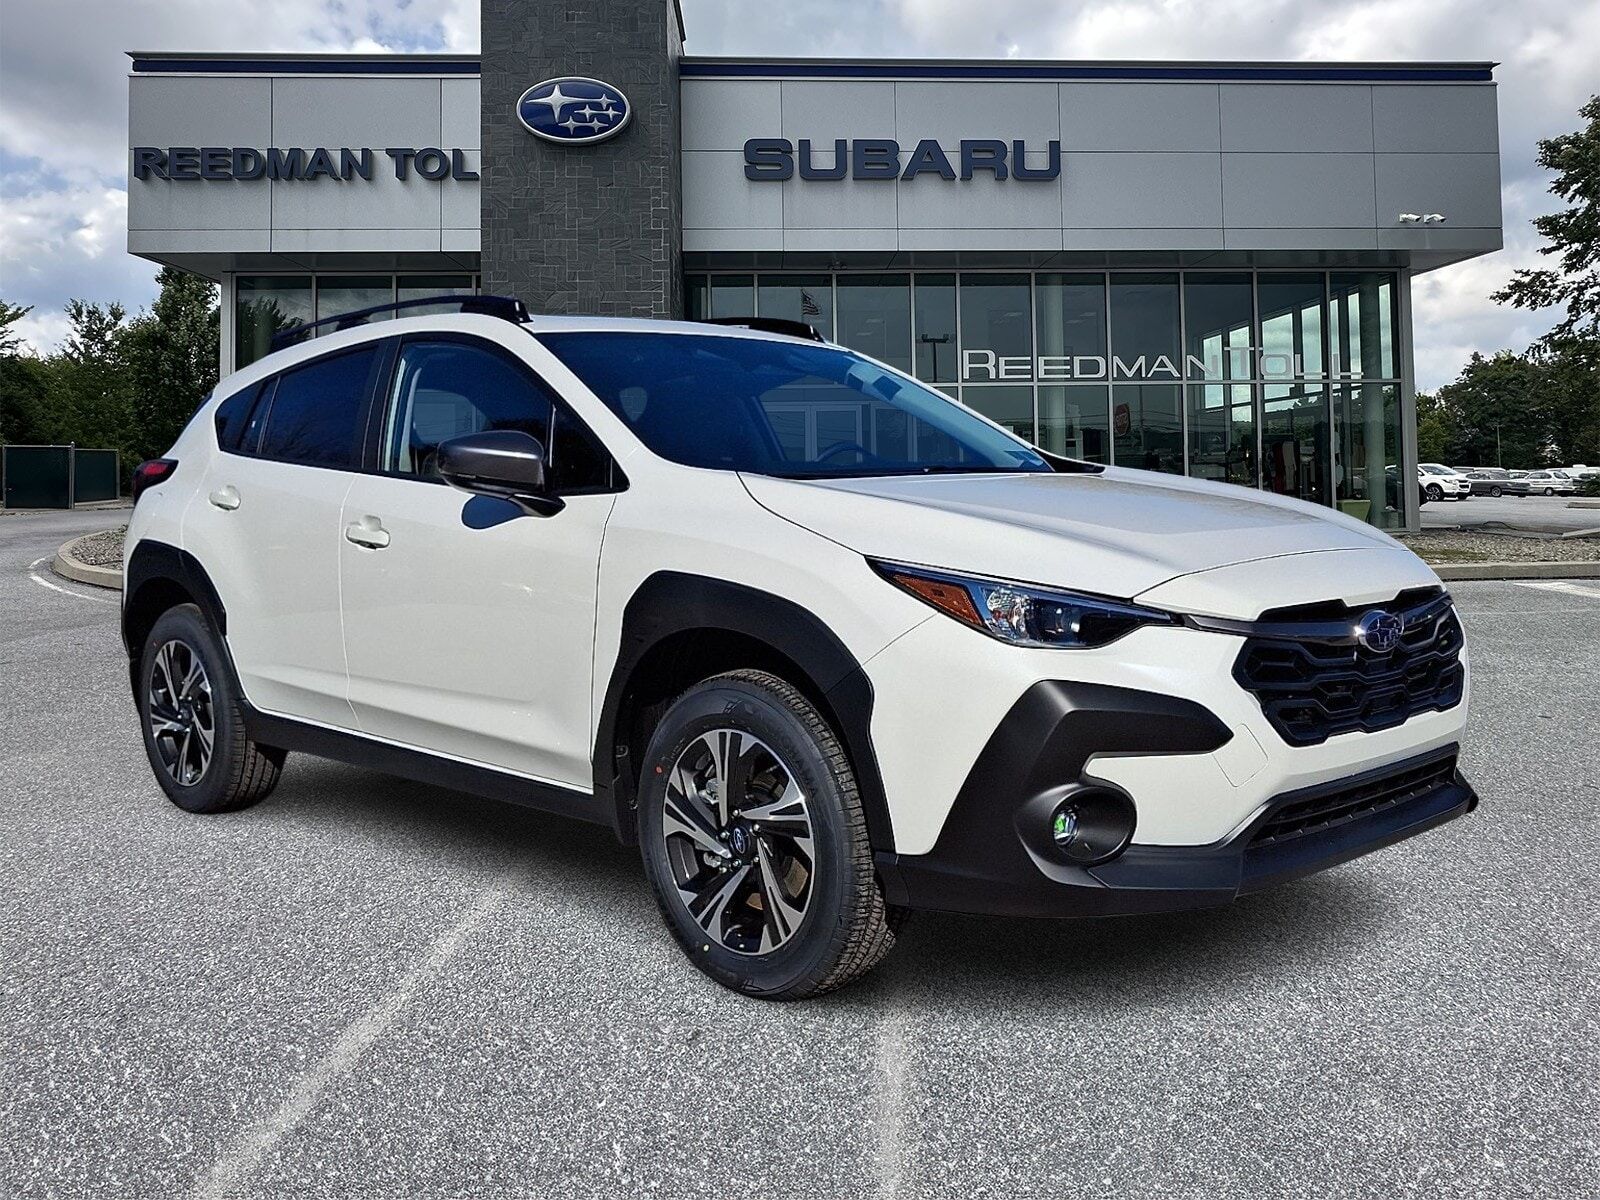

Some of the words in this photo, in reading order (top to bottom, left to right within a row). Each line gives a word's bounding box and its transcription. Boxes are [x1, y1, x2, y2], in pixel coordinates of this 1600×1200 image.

[134, 147, 372, 181] REEDMAN
[743, 138, 1061, 180] SUBARU
[962, 350, 1219, 379] REEDMAN
[1223, 346, 1364, 377] TOLL
